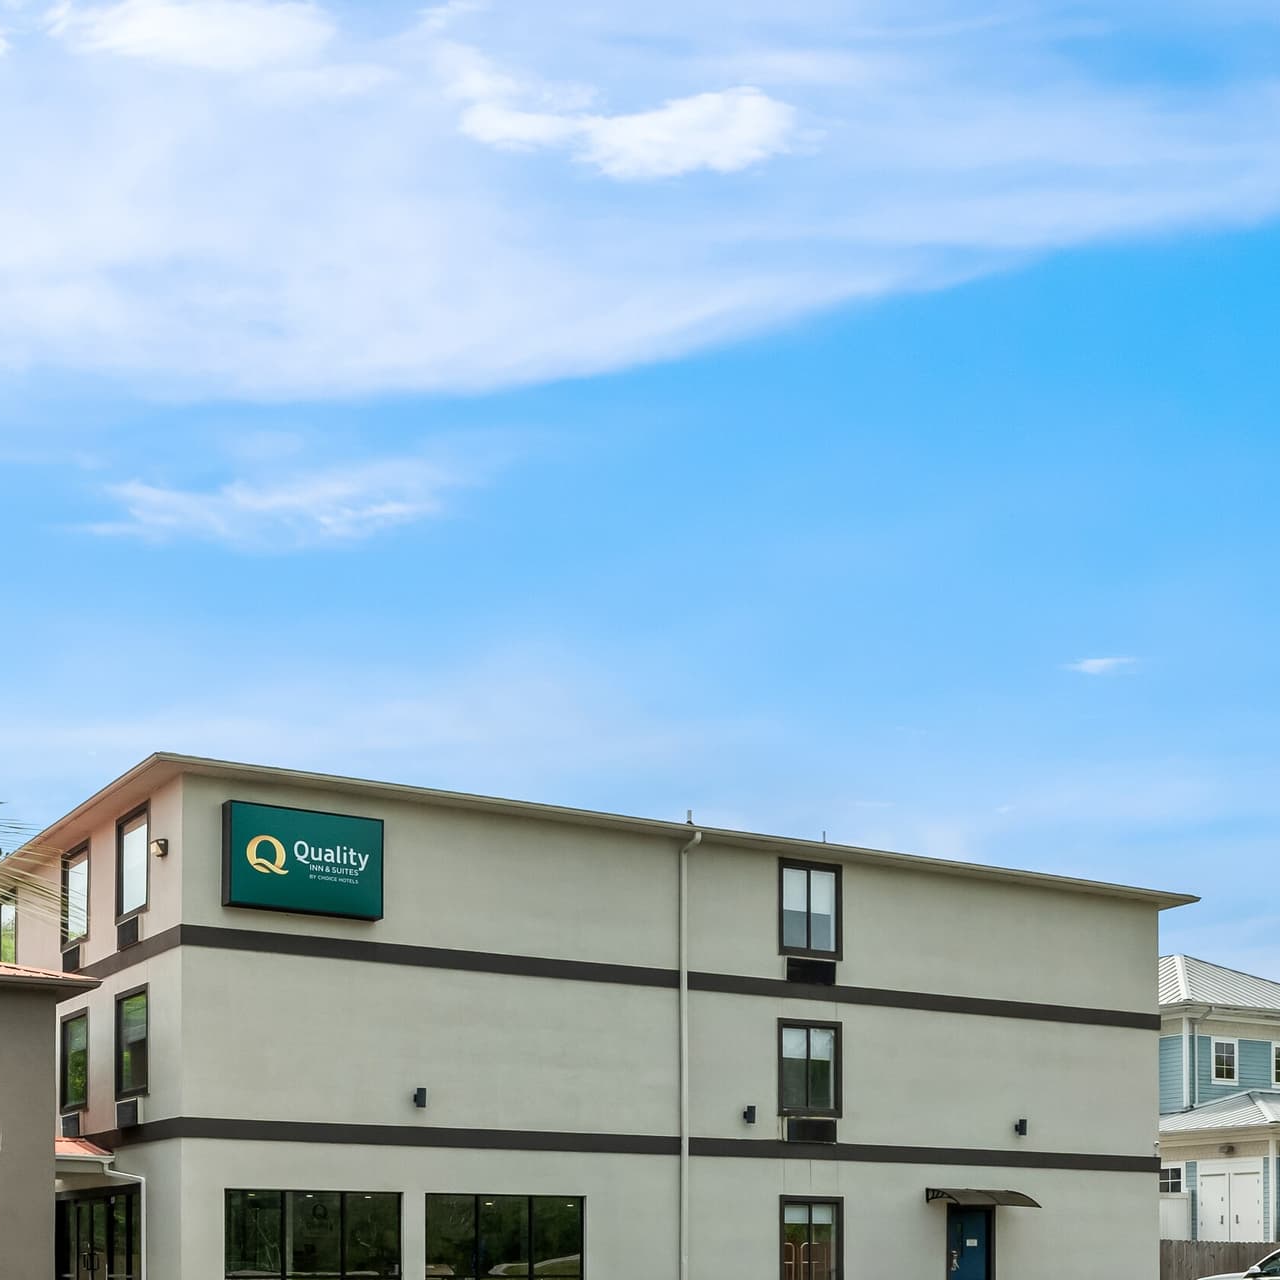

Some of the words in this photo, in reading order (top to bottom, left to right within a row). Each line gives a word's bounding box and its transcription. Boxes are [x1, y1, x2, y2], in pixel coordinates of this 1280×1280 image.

[246, 835, 289, 875] Q
[293, 840, 370, 871] Quality
[309, 863, 324, 872] INN
[332, 866, 359, 876] SUITES
